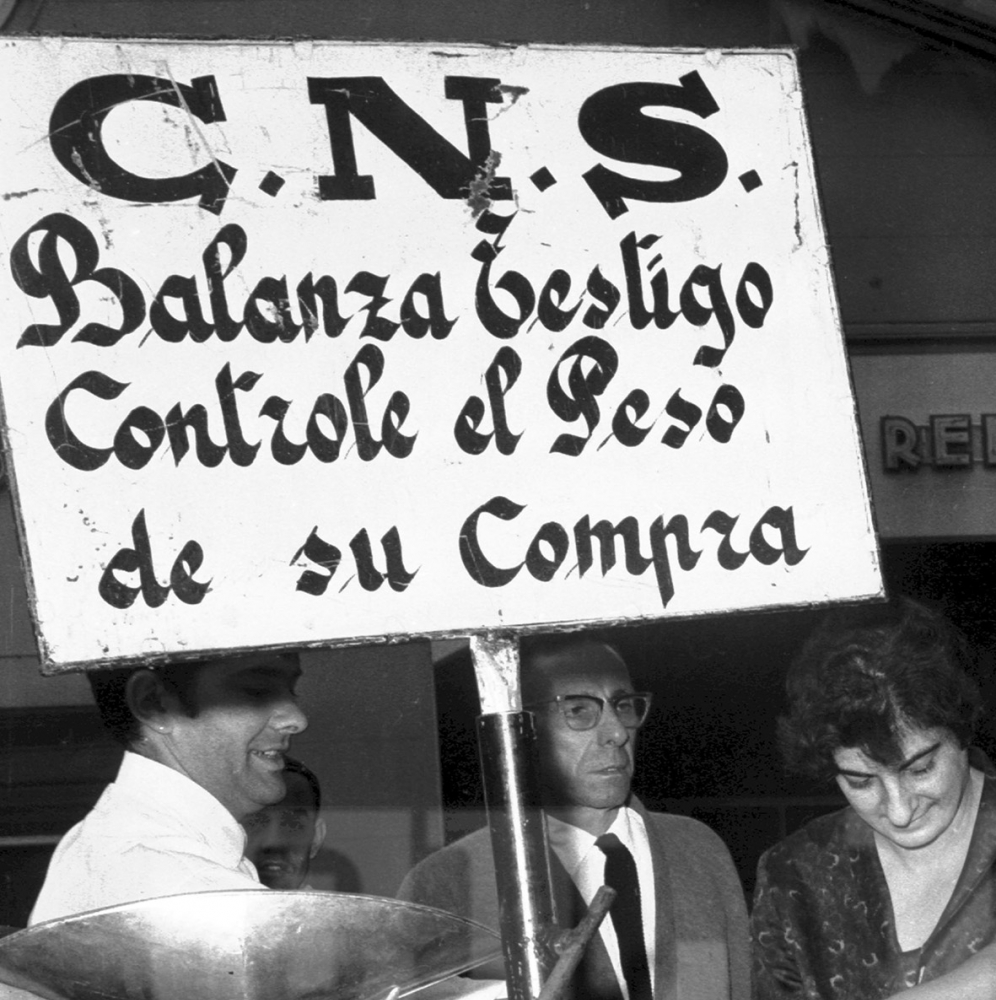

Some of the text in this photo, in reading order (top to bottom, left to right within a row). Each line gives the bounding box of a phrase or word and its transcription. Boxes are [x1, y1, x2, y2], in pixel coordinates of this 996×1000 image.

[48, 69, 764, 220] C.N.S.
[10, 211, 775, 368] Balanza Testigo
[44, 335, 746, 472] Controle el Peso
[97, 495, 812, 609] de su Compra
